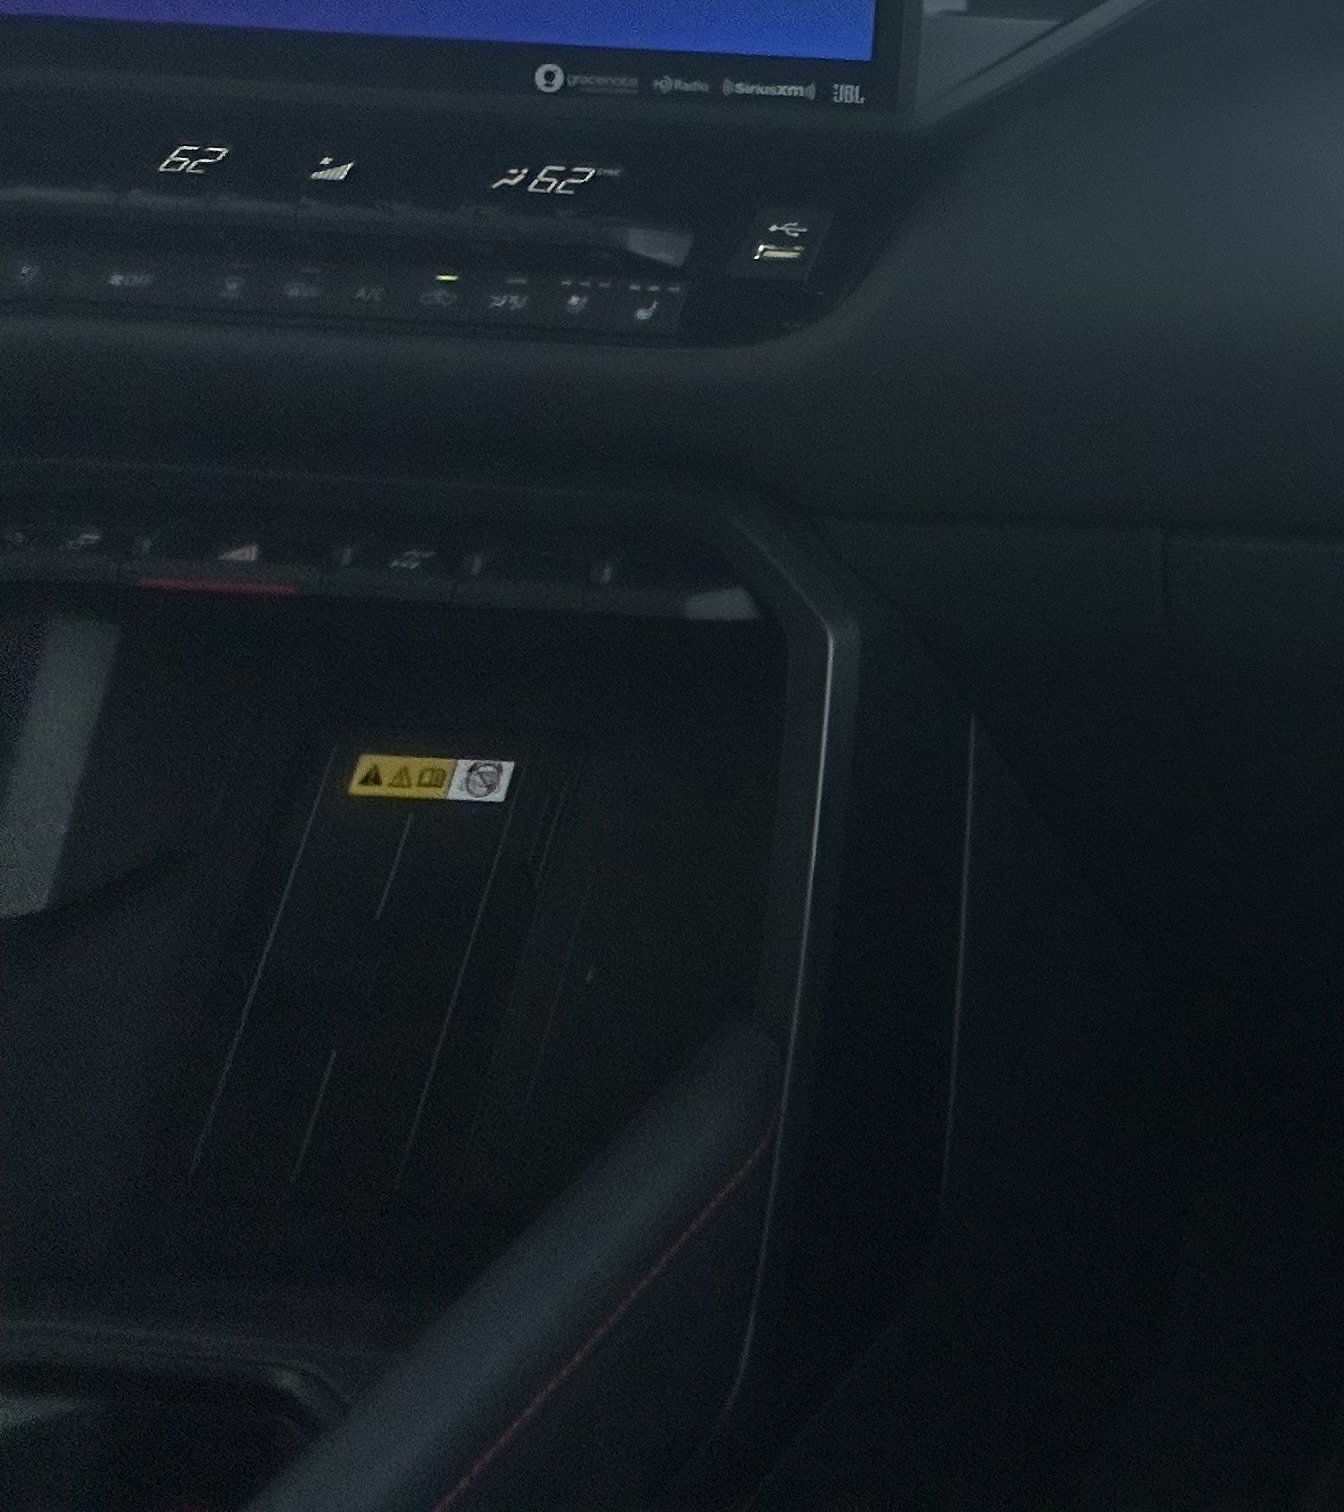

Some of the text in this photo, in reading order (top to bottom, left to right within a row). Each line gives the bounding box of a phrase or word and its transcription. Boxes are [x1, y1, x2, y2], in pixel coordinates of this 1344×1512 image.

[832, 83, 866, 104] JBL
[157, 144, 229, 174] 62
[526, 165, 596, 195] 62
